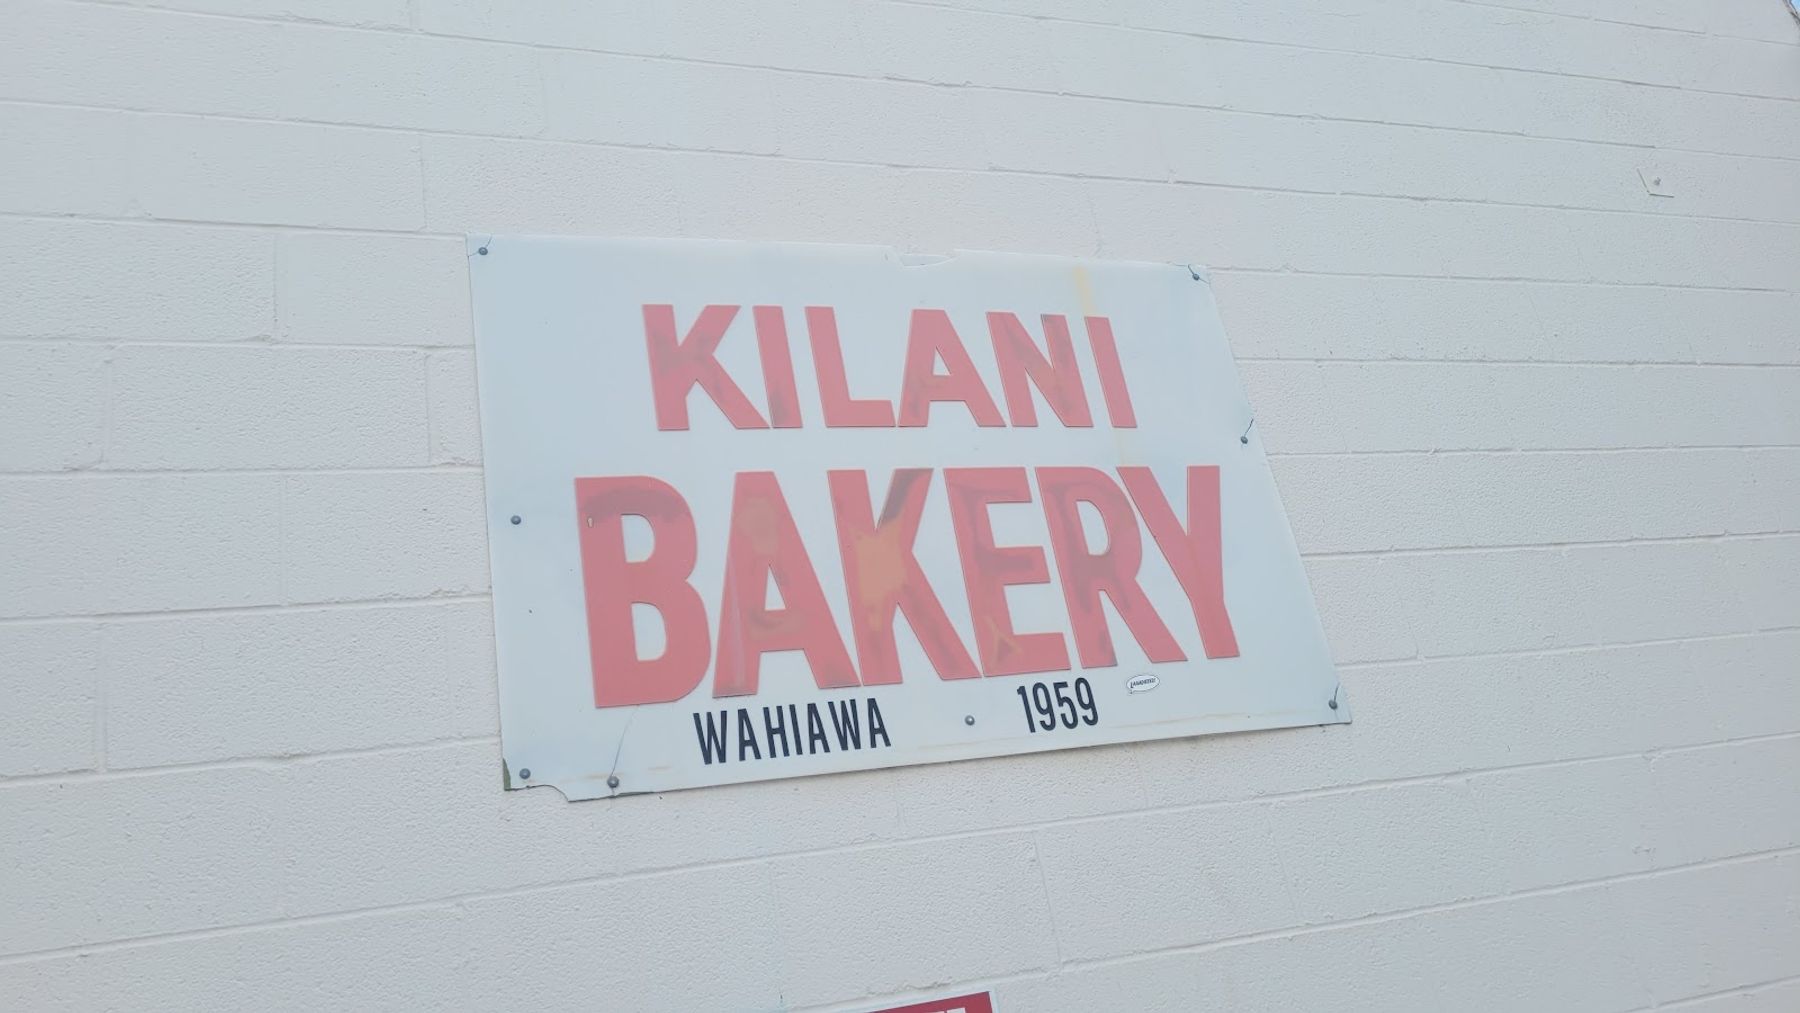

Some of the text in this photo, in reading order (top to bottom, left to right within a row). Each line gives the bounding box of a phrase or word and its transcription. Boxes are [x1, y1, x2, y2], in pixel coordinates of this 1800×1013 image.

[643, 304, 1138, 431] KILANI
[574, 465, 1241, 708] BAKERY
[693, 677, 1099, 765] WAHIAWA 1959
